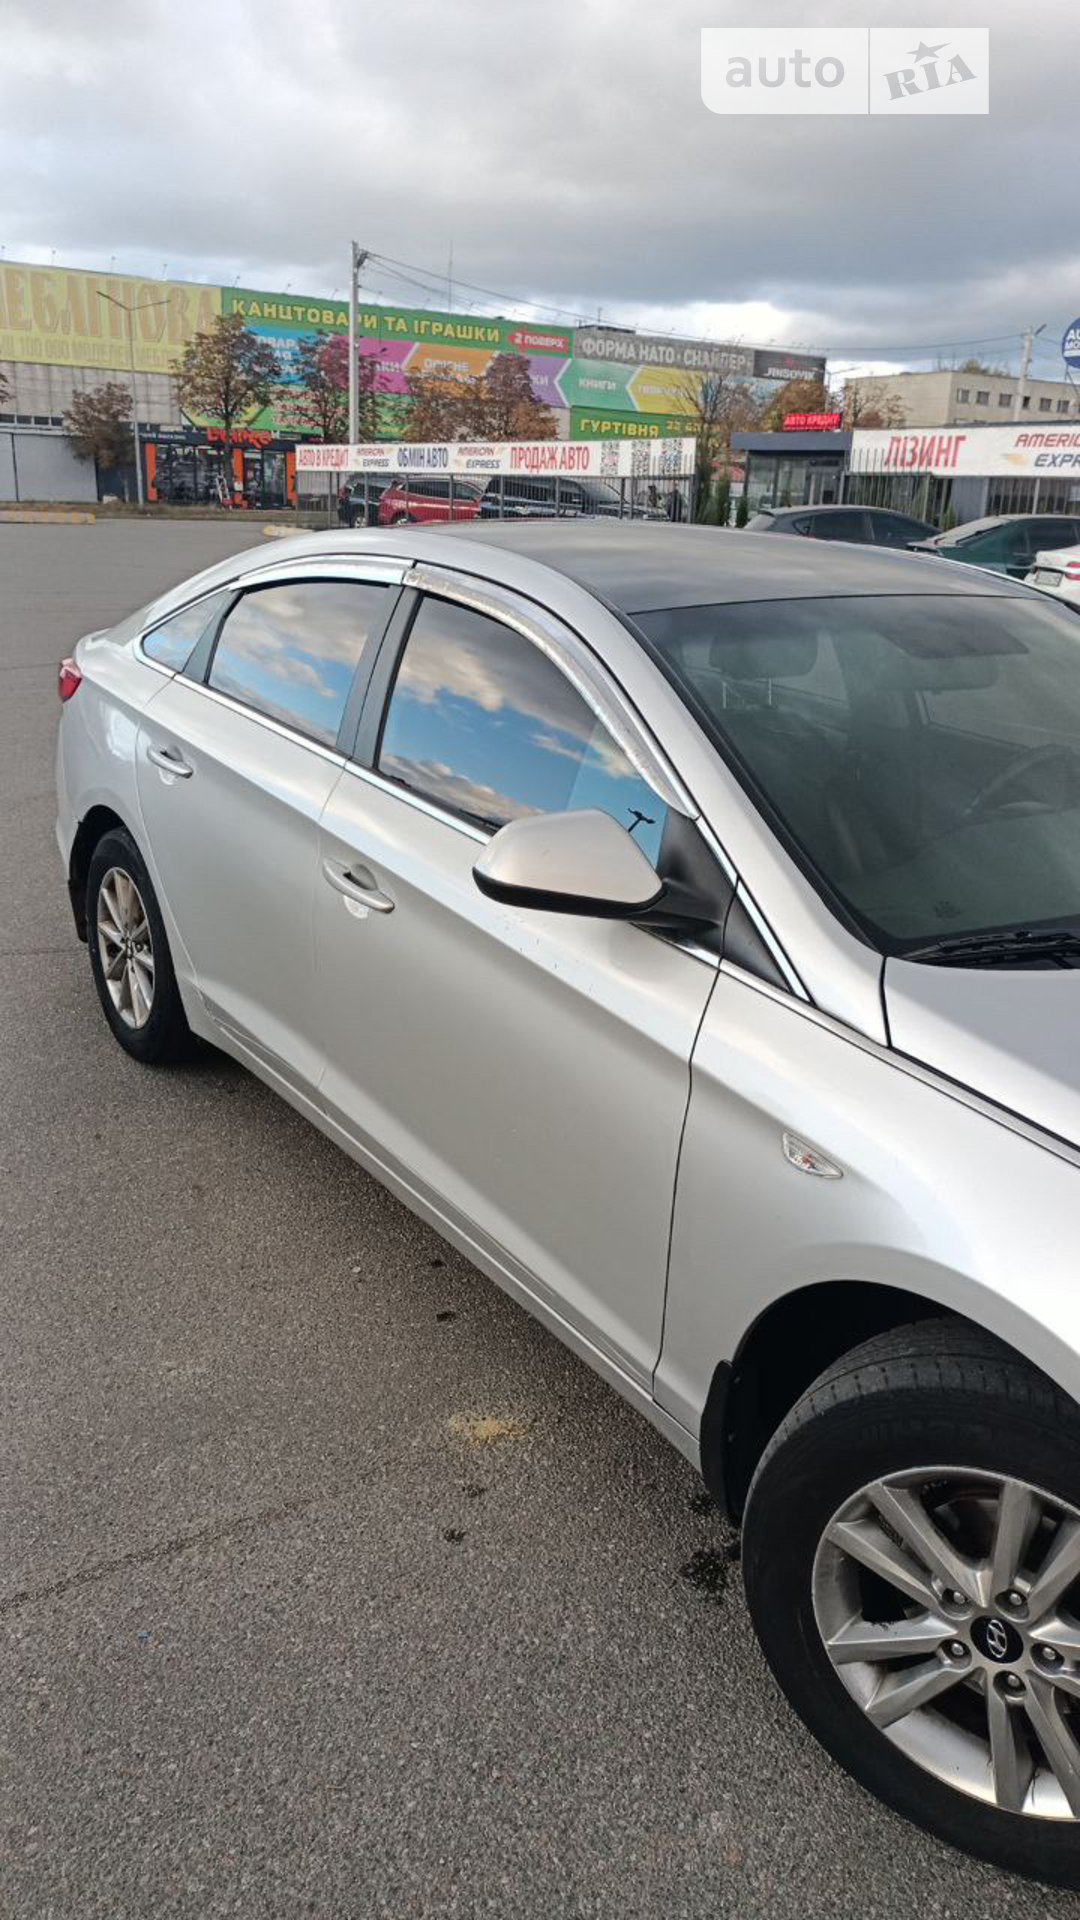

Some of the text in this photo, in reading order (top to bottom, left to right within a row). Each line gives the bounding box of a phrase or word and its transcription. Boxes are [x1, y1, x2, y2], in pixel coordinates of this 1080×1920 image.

[384, 316, 408, 333] ТА
[414, 320, 500, 343] ІГРАШКИ
[514, 333, 565, 348] 2 ПОВЕРХ
[582, 338, 636, 361] ФОРМА
[639, 344, 676, 364] НАТО
[580, 419, 661, 437] ГУРТІВНЯ
[397, 447, 448, 467] ОБМІН АВТО
[510, 446, 590, 473] ПРОДАЖ АВТО
[883, 435, 966, 468] ЛІЗИНГ
[466, 459, 500, 469] EXPRESS
